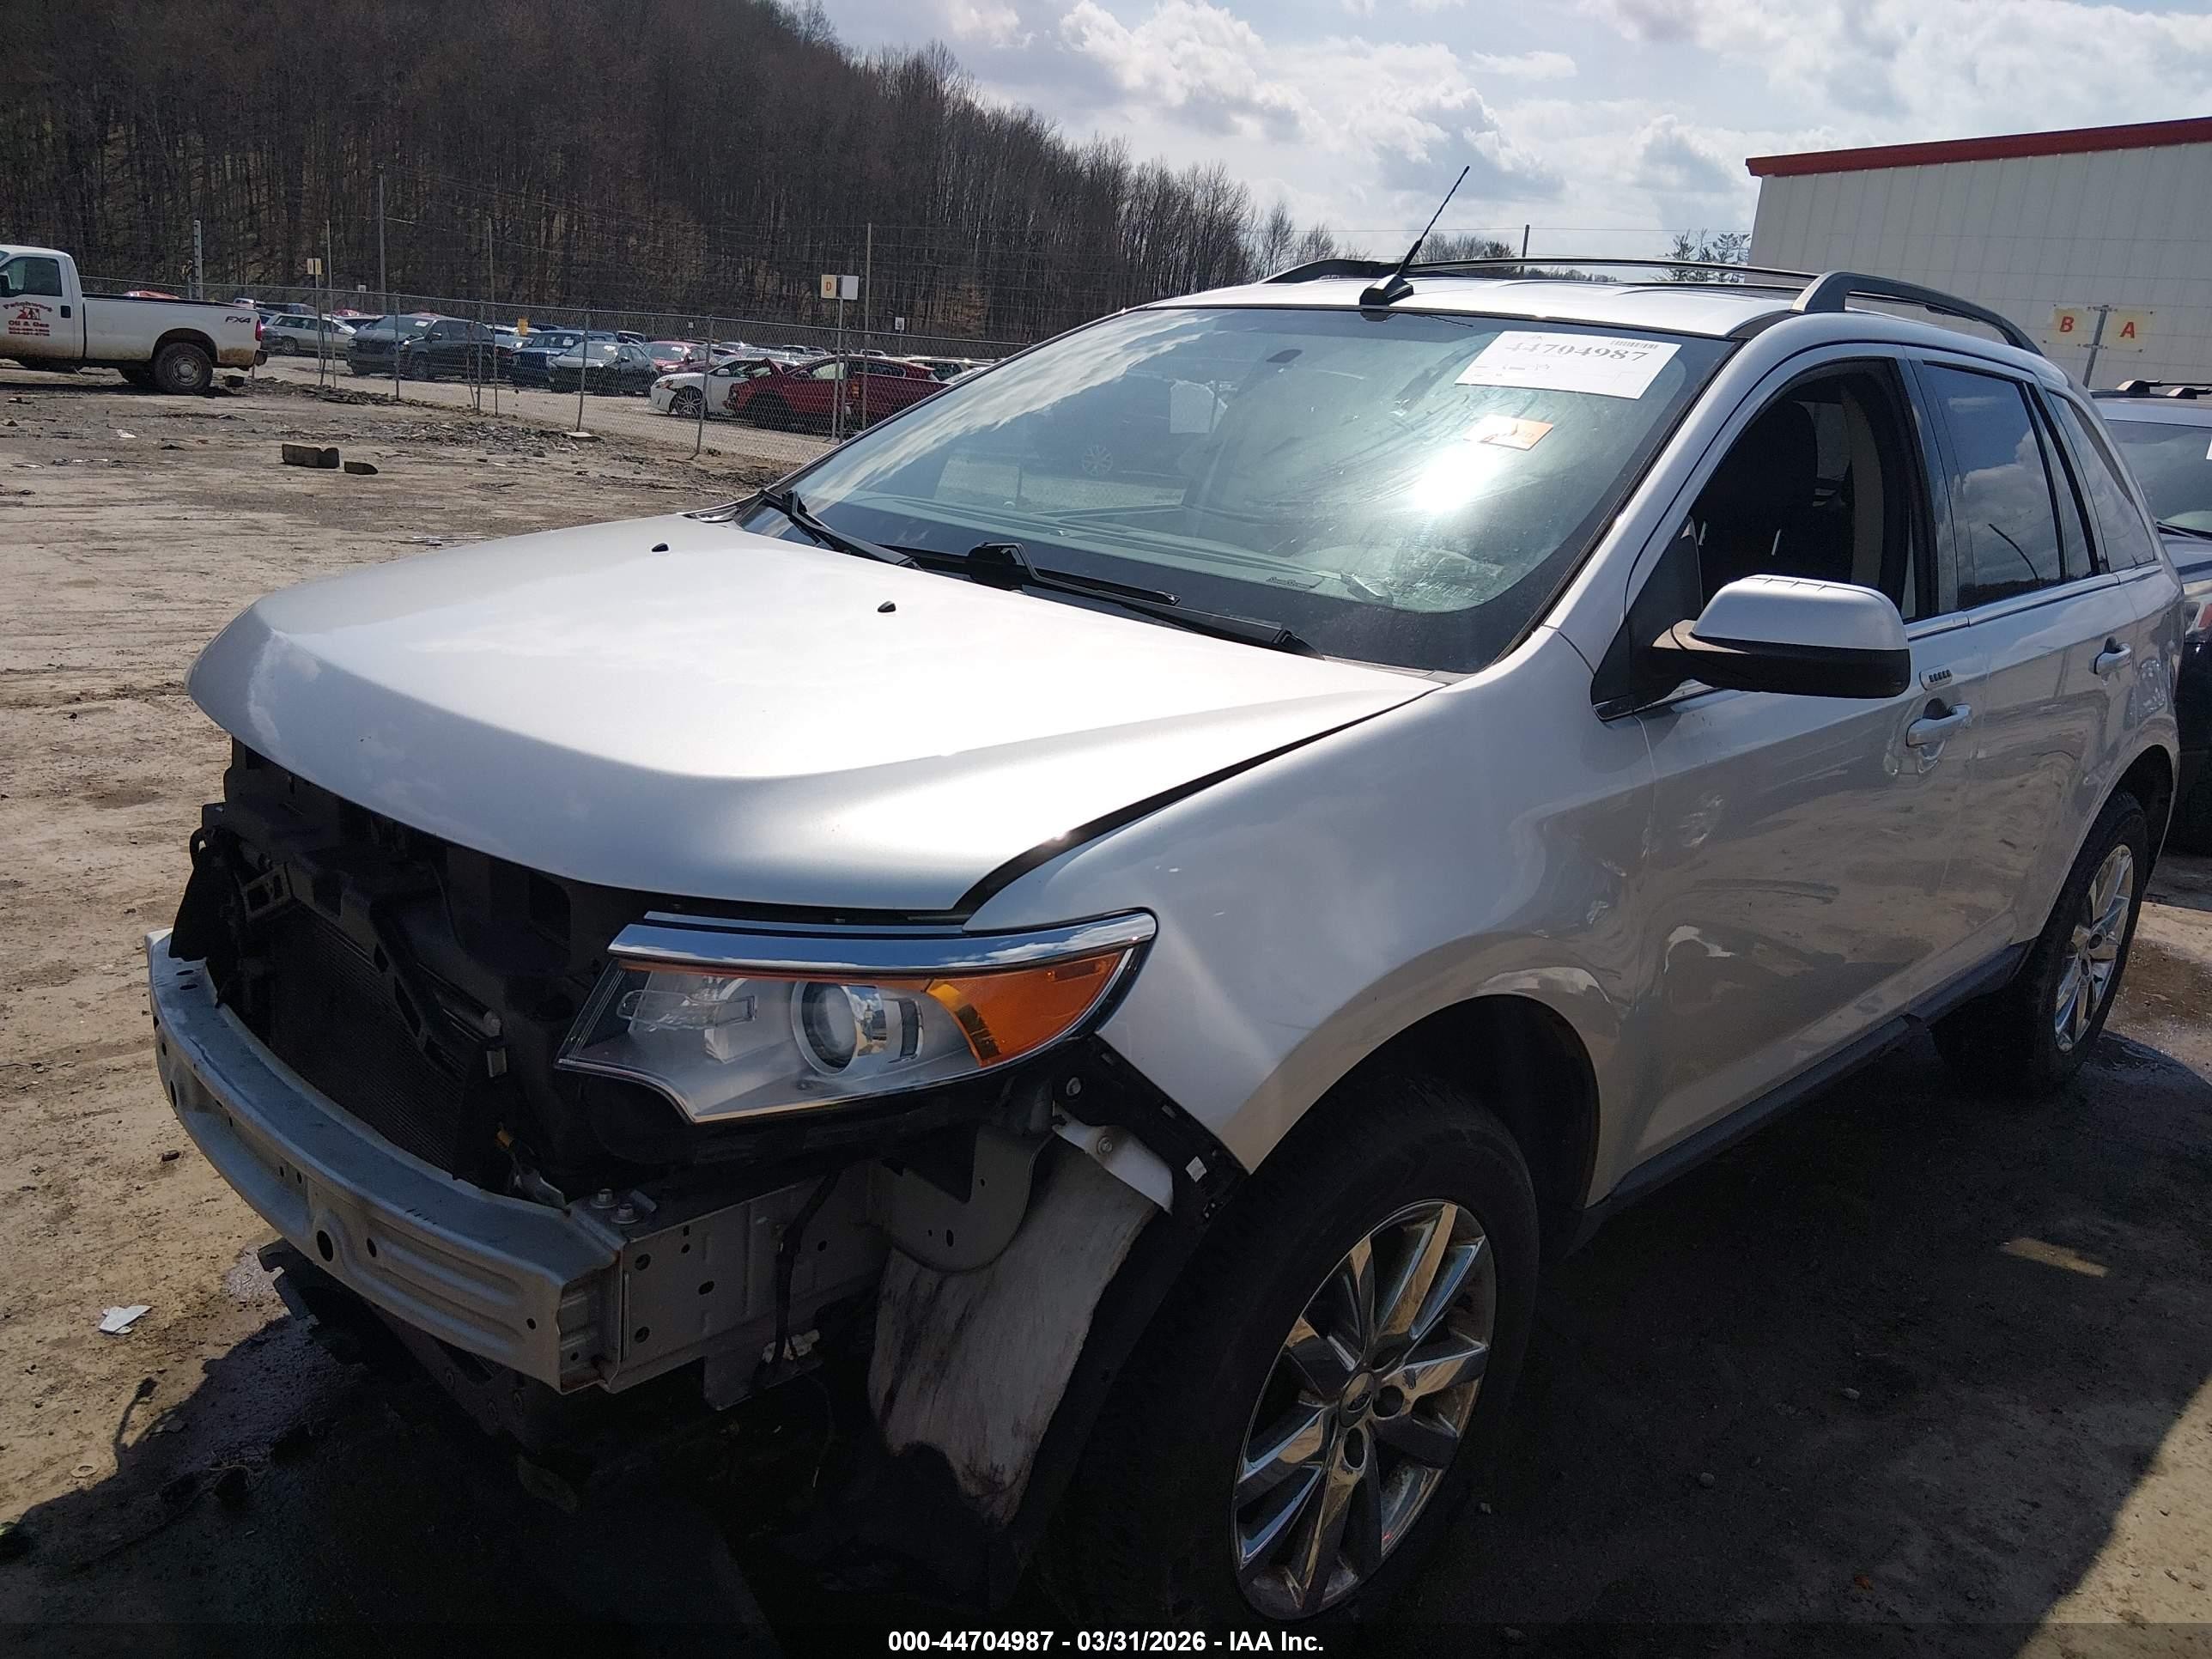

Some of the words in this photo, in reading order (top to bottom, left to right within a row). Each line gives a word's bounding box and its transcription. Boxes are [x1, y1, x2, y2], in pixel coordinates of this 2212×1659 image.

[825, 281, 832, 291] D
[225, 315, 252, 324] FX4
[2060, 316, 2074, 333] B
[2119, 321, 2135, 338] A
[1505, 342, 1649, 362] 44704987
